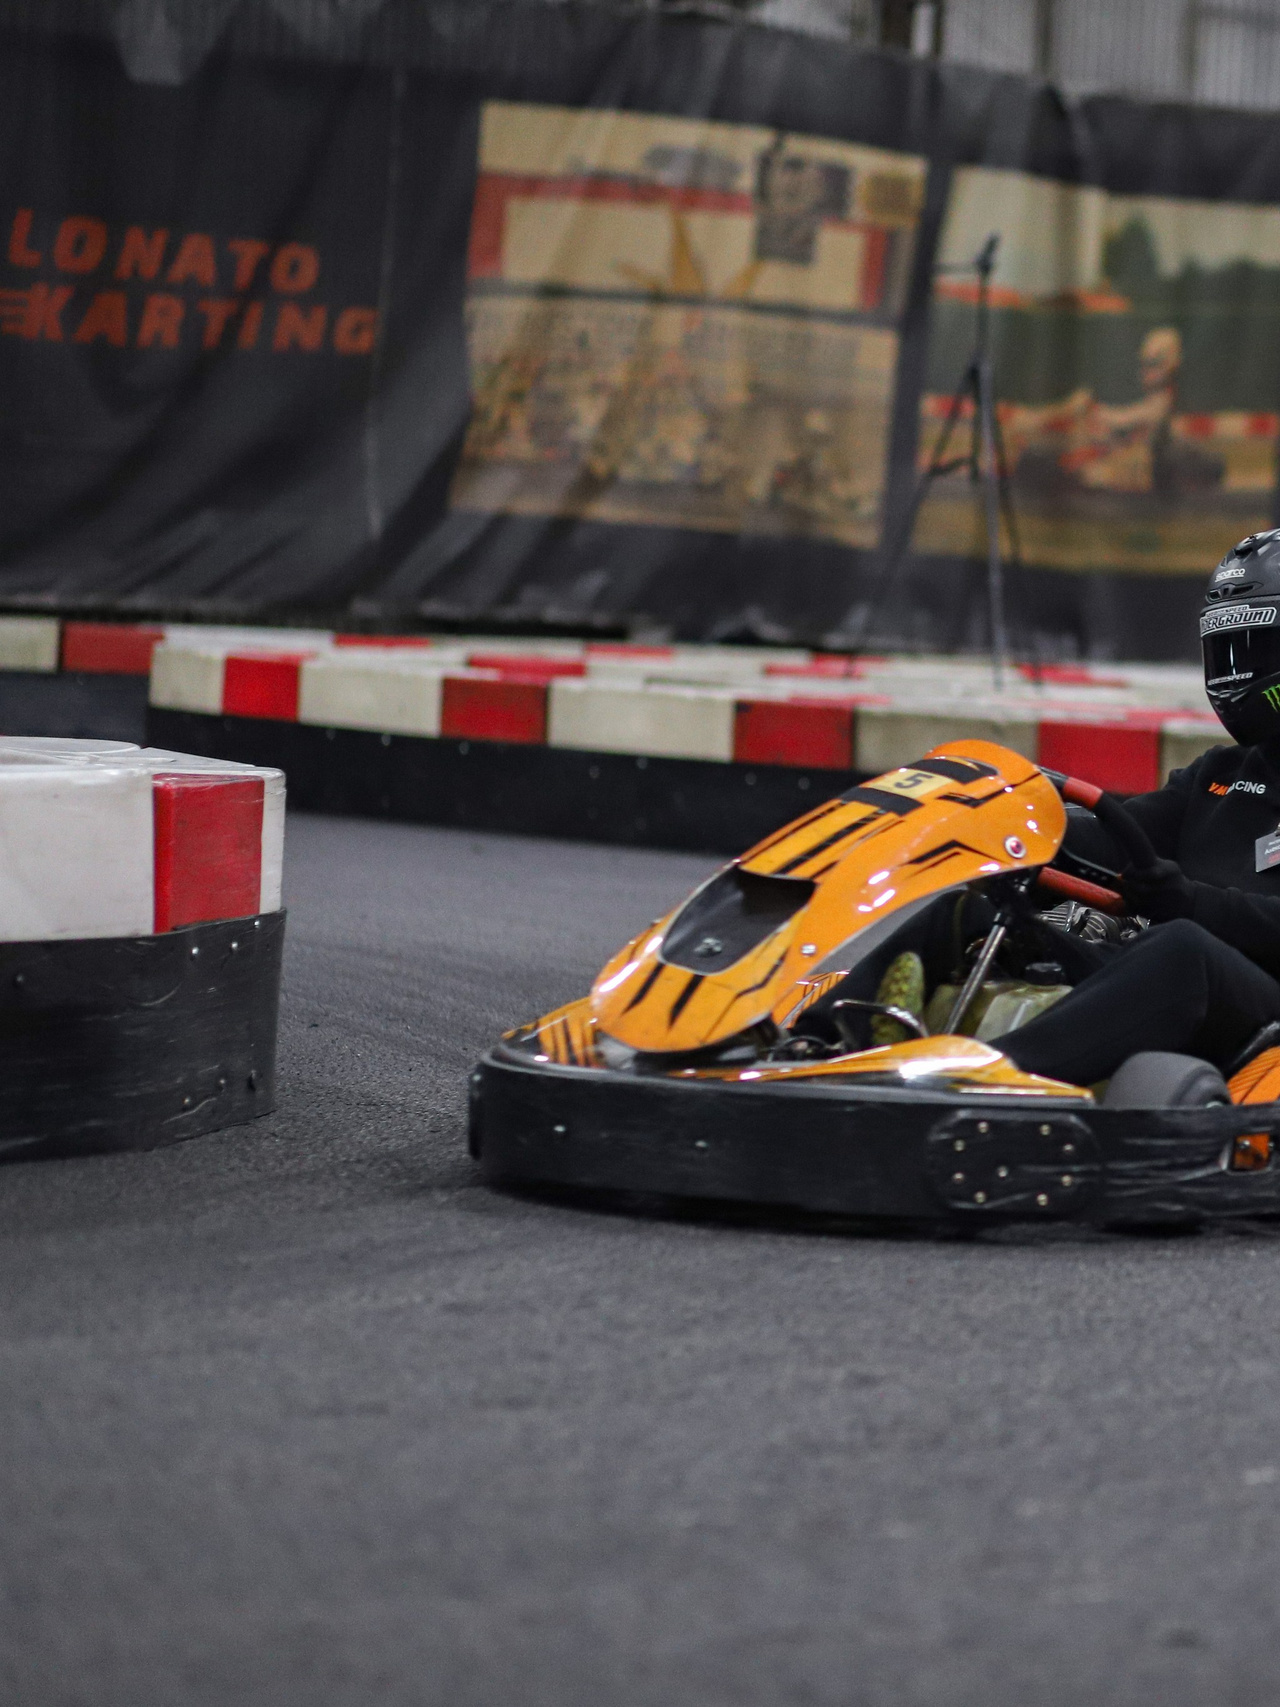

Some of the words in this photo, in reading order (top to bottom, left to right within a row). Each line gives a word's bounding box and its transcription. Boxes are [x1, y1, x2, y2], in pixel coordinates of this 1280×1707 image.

[7, 207, 321, 295] LONATO
[20, 282, 380, 356] KARTING
[894, 772, 934, 789] 5
